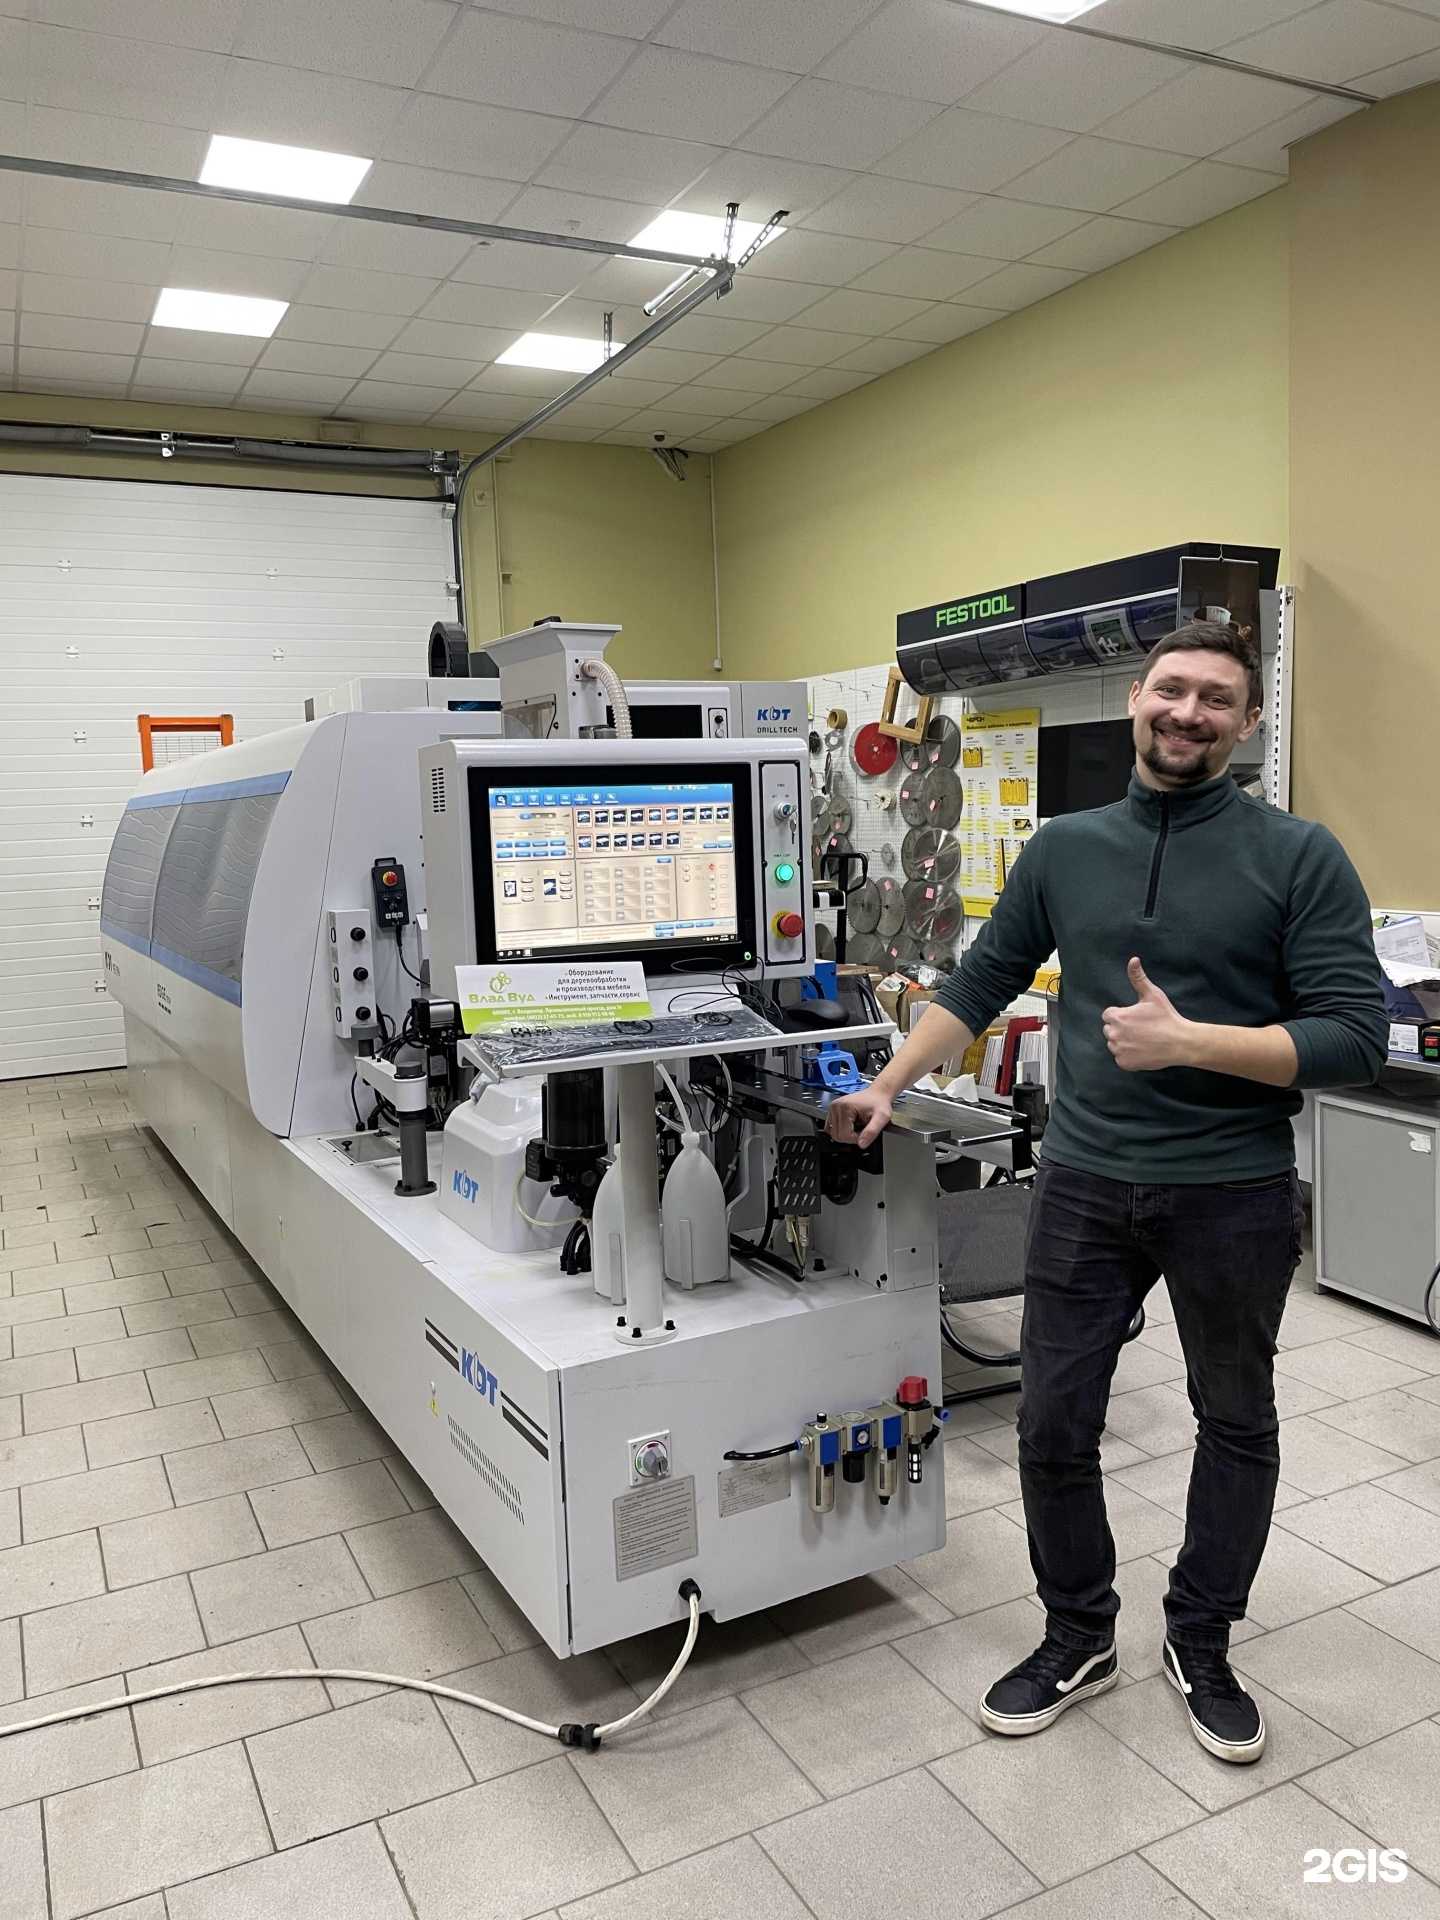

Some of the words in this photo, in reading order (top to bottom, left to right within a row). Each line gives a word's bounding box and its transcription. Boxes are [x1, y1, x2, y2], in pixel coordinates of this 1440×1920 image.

[936, 595, 1015, 628] FESTOOL
[780, 726, 798, 734] TECH
[568, 969, 614, 978] Оборудование
[571, 976, 627, 985] деревообработки
[562, 985, 606, 993] производства
[548, 993, 589, 1002] Инструмент,
